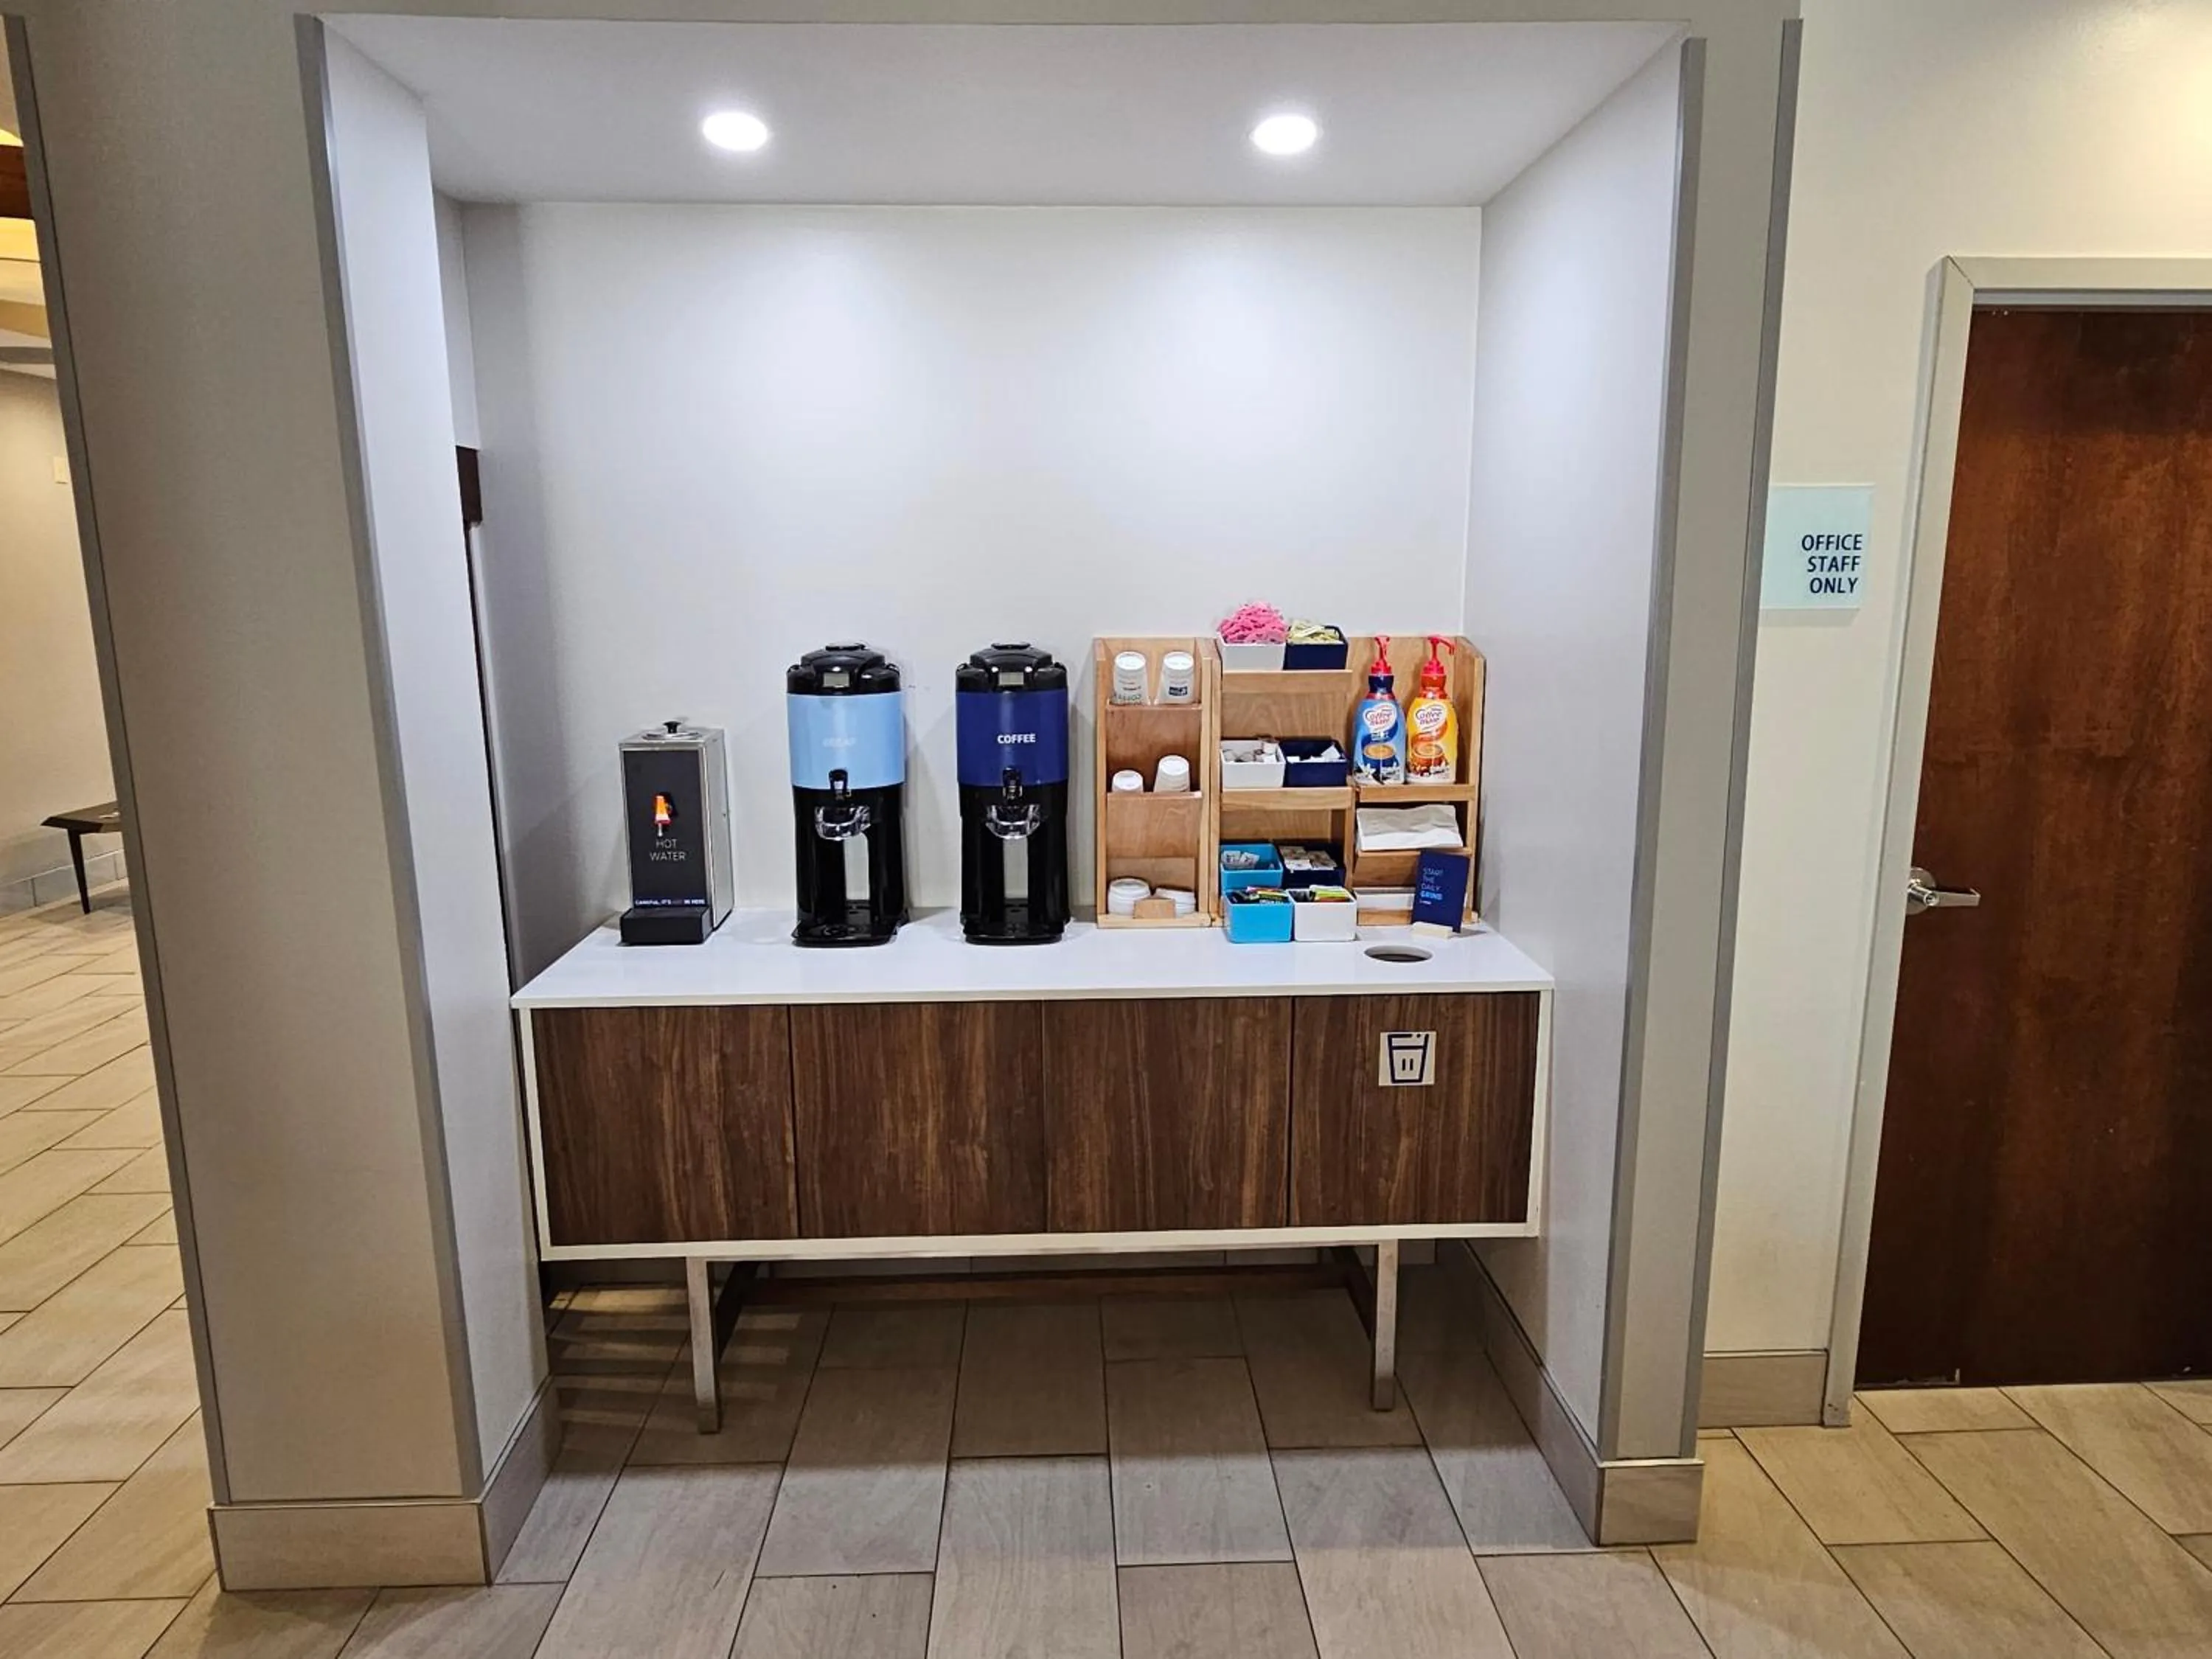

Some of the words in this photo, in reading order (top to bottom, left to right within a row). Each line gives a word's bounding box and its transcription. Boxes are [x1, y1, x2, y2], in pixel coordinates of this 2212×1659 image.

[1801, 534, 1863, 551] OFFICE
[1806, 555, 1861, 572] STAFF
[1809, 577, 1858, 594] ONLY
[998, 734, 1036, 744] COFFEE
[655, 838, 678, 849] HOT
[650, 852, 686, 861] WATER
